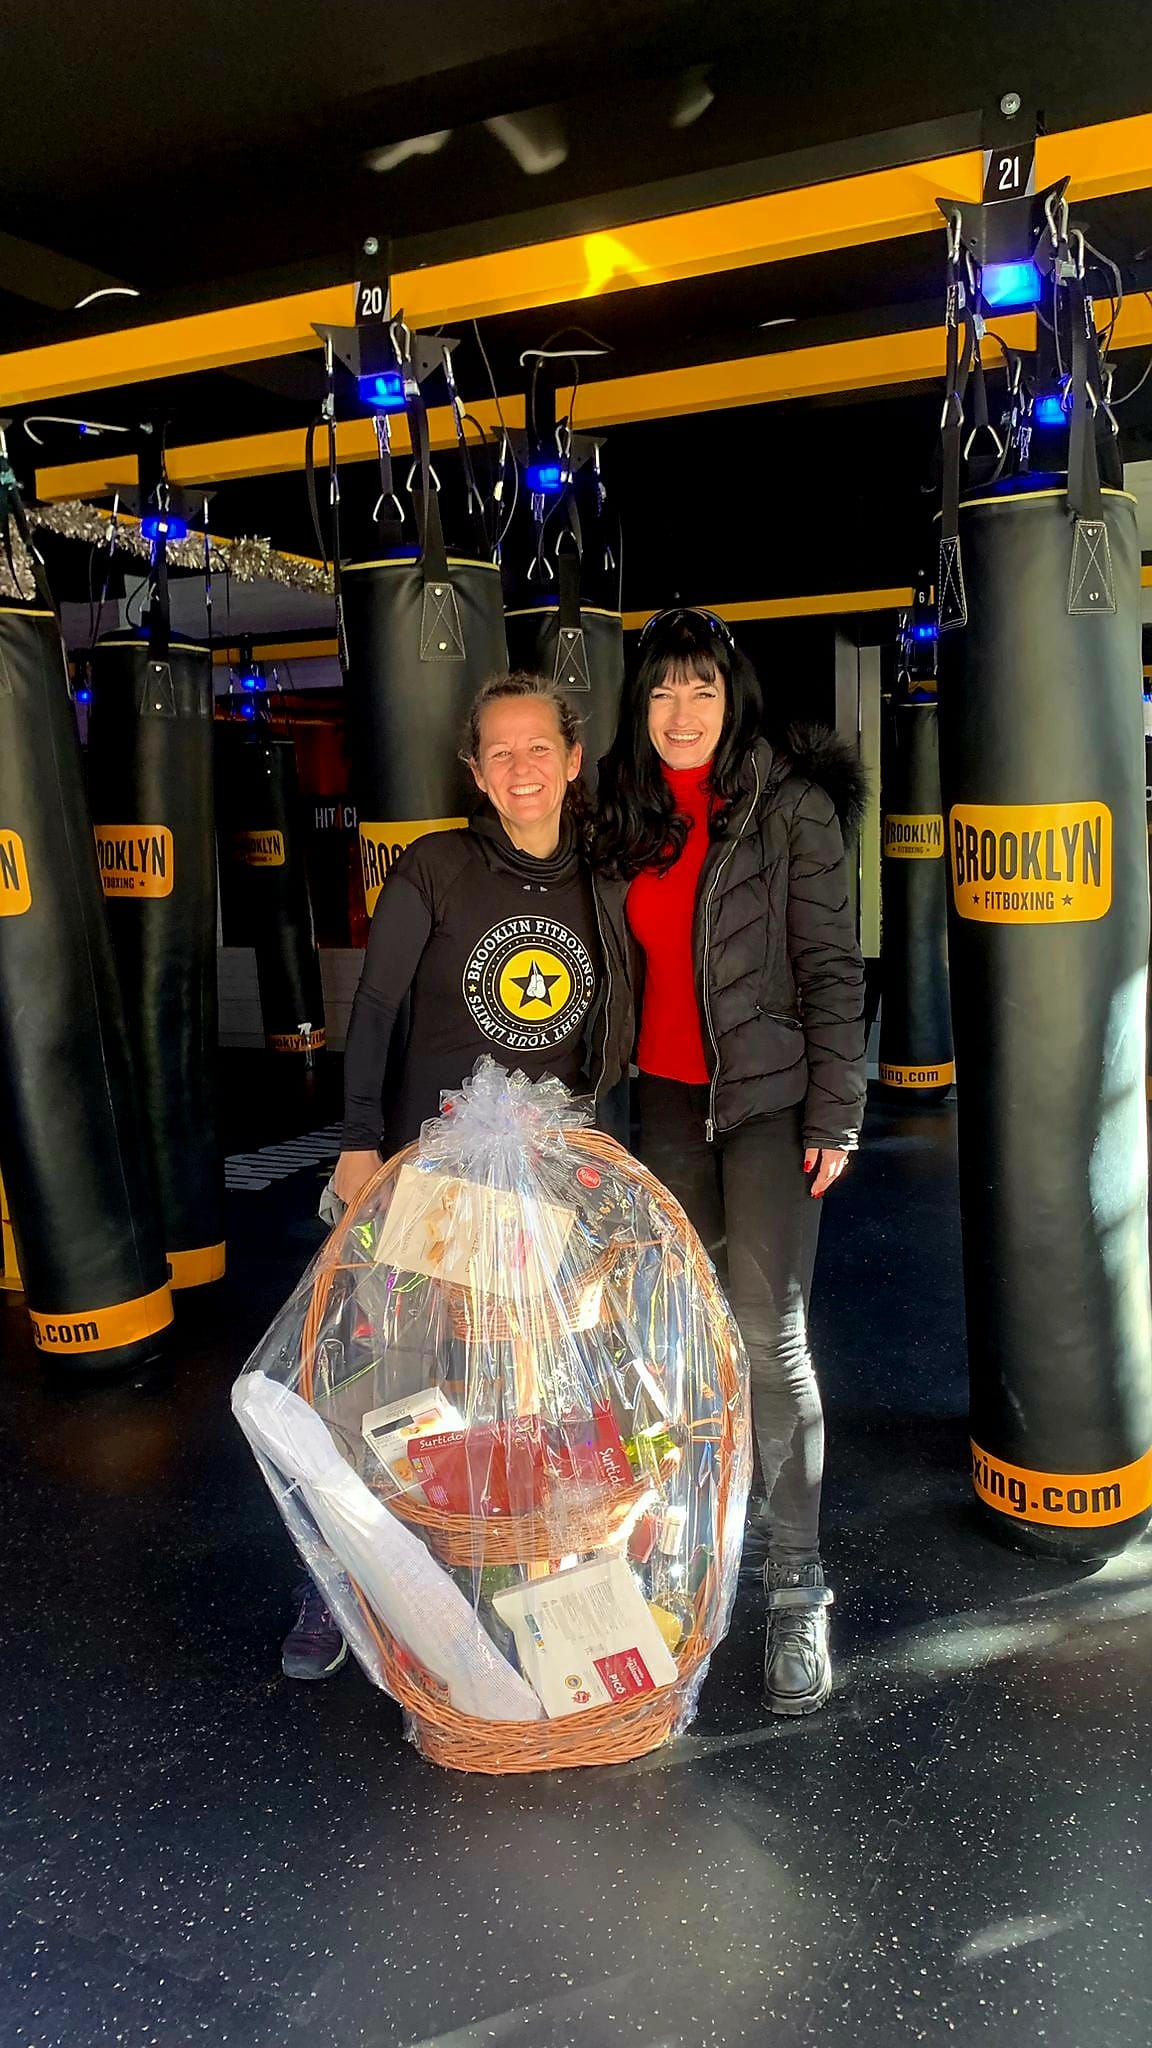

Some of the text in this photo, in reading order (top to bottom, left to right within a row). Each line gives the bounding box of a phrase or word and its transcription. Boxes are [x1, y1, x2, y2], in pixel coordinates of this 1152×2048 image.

[999, 156, 1019, 190] 21
[362, 286, 382, 315] 20
[918, 591, 925, 604] 6
[954, 816, 1101, 887] BROOKLYN
[984, 891, 1054, 910] FITBOXING
[467, 920, 593, 986] BROOKLYN FITBOXING
[468, 995, 588, 1047] FIGHT YOUR LIMITS
[419, 1433, 464, 1449] Surtido
[973, 1454, 1121, 1513] xing.com
